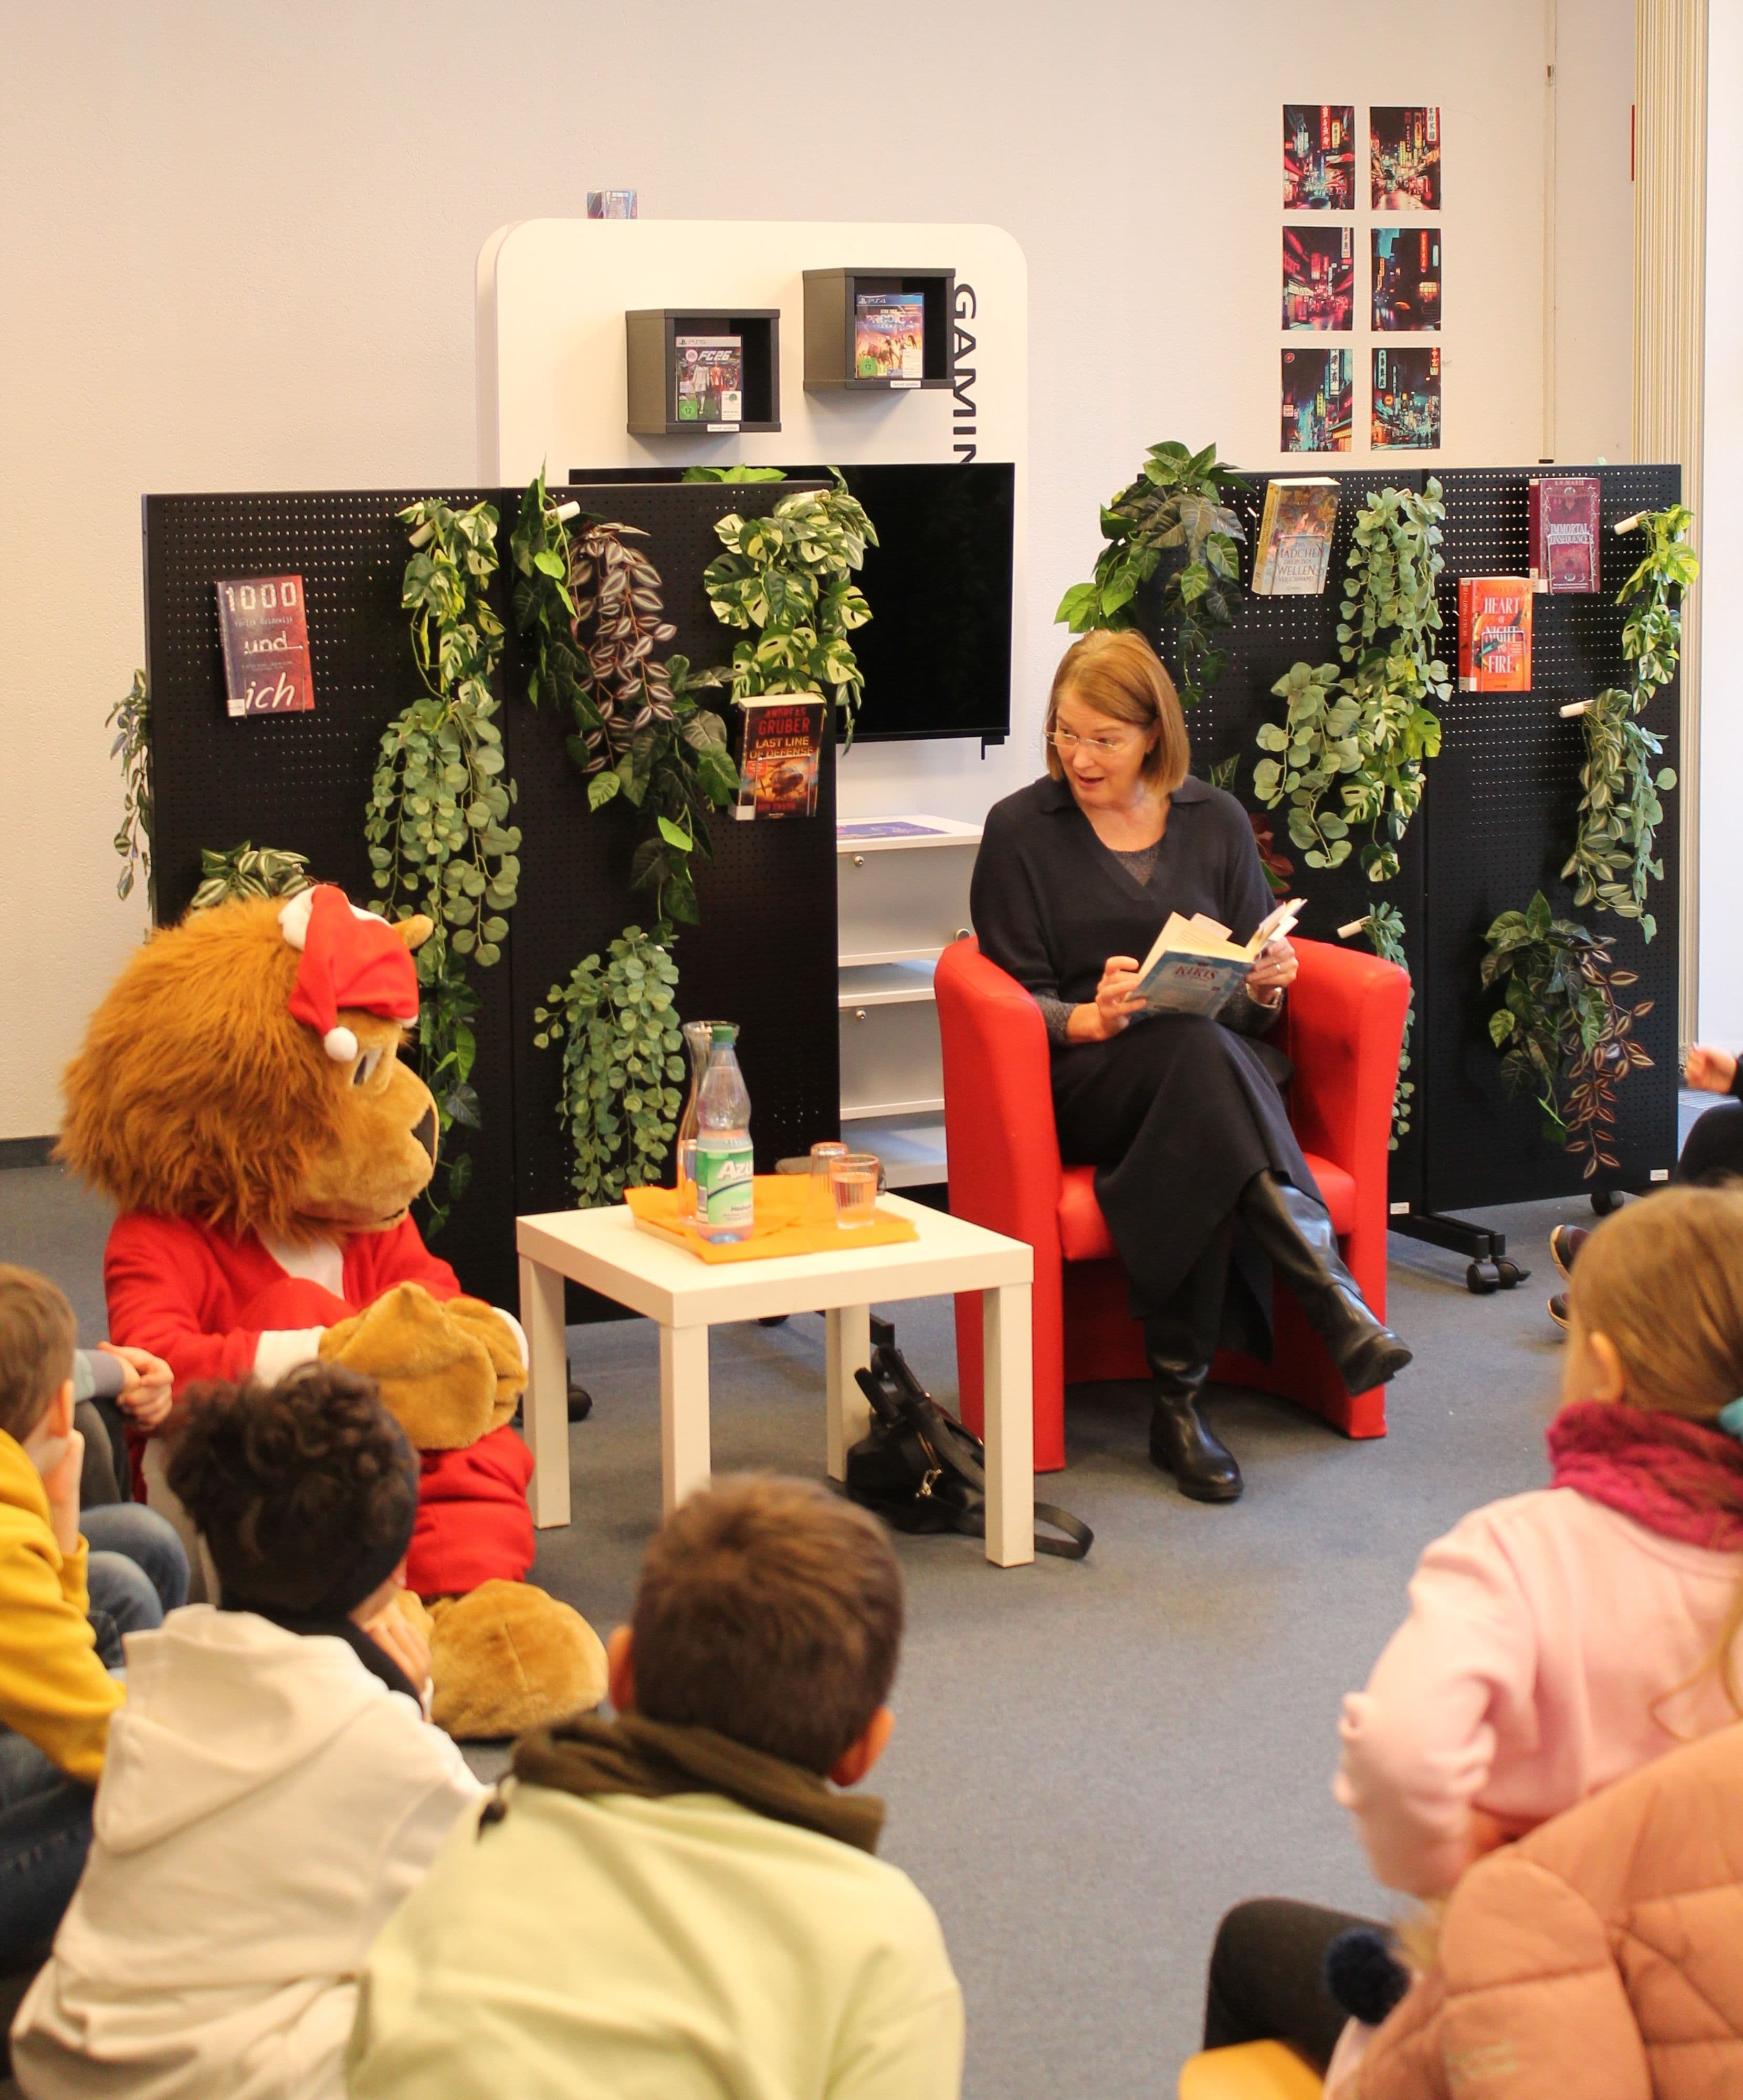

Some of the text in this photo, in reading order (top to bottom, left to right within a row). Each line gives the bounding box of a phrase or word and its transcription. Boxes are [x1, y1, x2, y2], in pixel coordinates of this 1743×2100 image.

[1550, 523, 1588, 535] IMMORTAL
[226, 582, 296, 612] 1000
[1484, 596, 1521, 614] HEART
[244, 630, 288, 655] und
[1485, 626, 1518, 643] NIGHT
[1488, 656, 1515, 674] FIRE
[246, 672, 295, 709] ich
[758, 717, 810, 735] GRUBER
[756, 736, 810, 748] LAST LINE
[766, 747, 813, 758] DEFENSE
